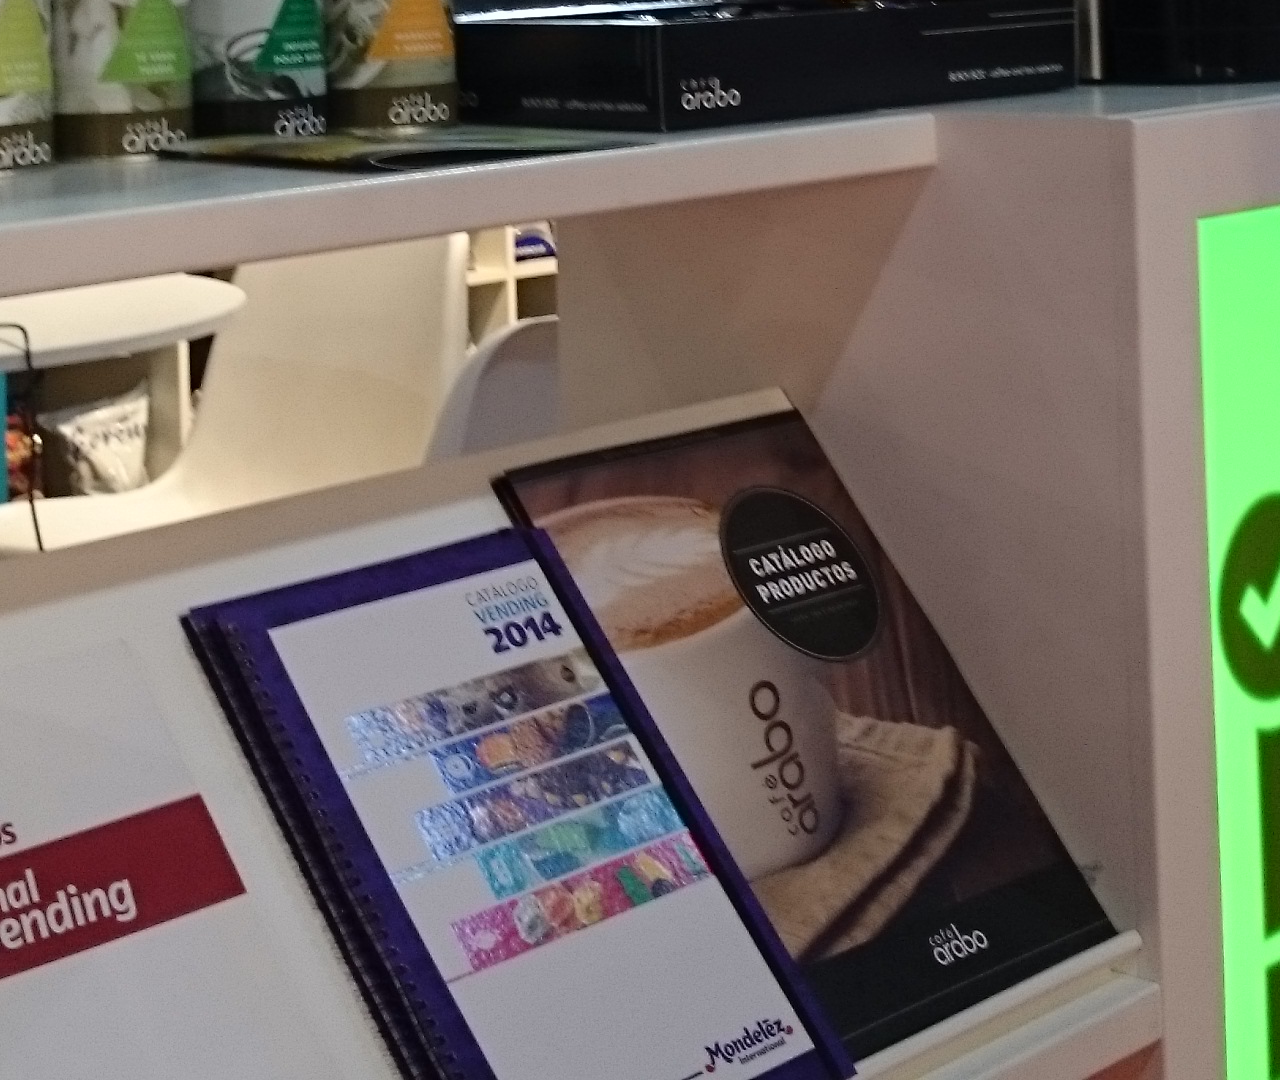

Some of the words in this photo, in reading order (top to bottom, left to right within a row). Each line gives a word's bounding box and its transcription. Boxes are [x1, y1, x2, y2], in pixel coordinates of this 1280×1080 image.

[387, 91, 450, 125] arabo
[681, 77, 741, 110] arabo
[274, 104, 326, 136] arabo
[748, 539, 837, 578] CATÁLOGO
[755, 561, 858, 604] PRODUCTOS
[473, 592, 549, 624] VENDING
[483, 610, 562, 654] 2014
[749, 680, 819, 834] arabo
[933, 923, 989, 966] arabo
